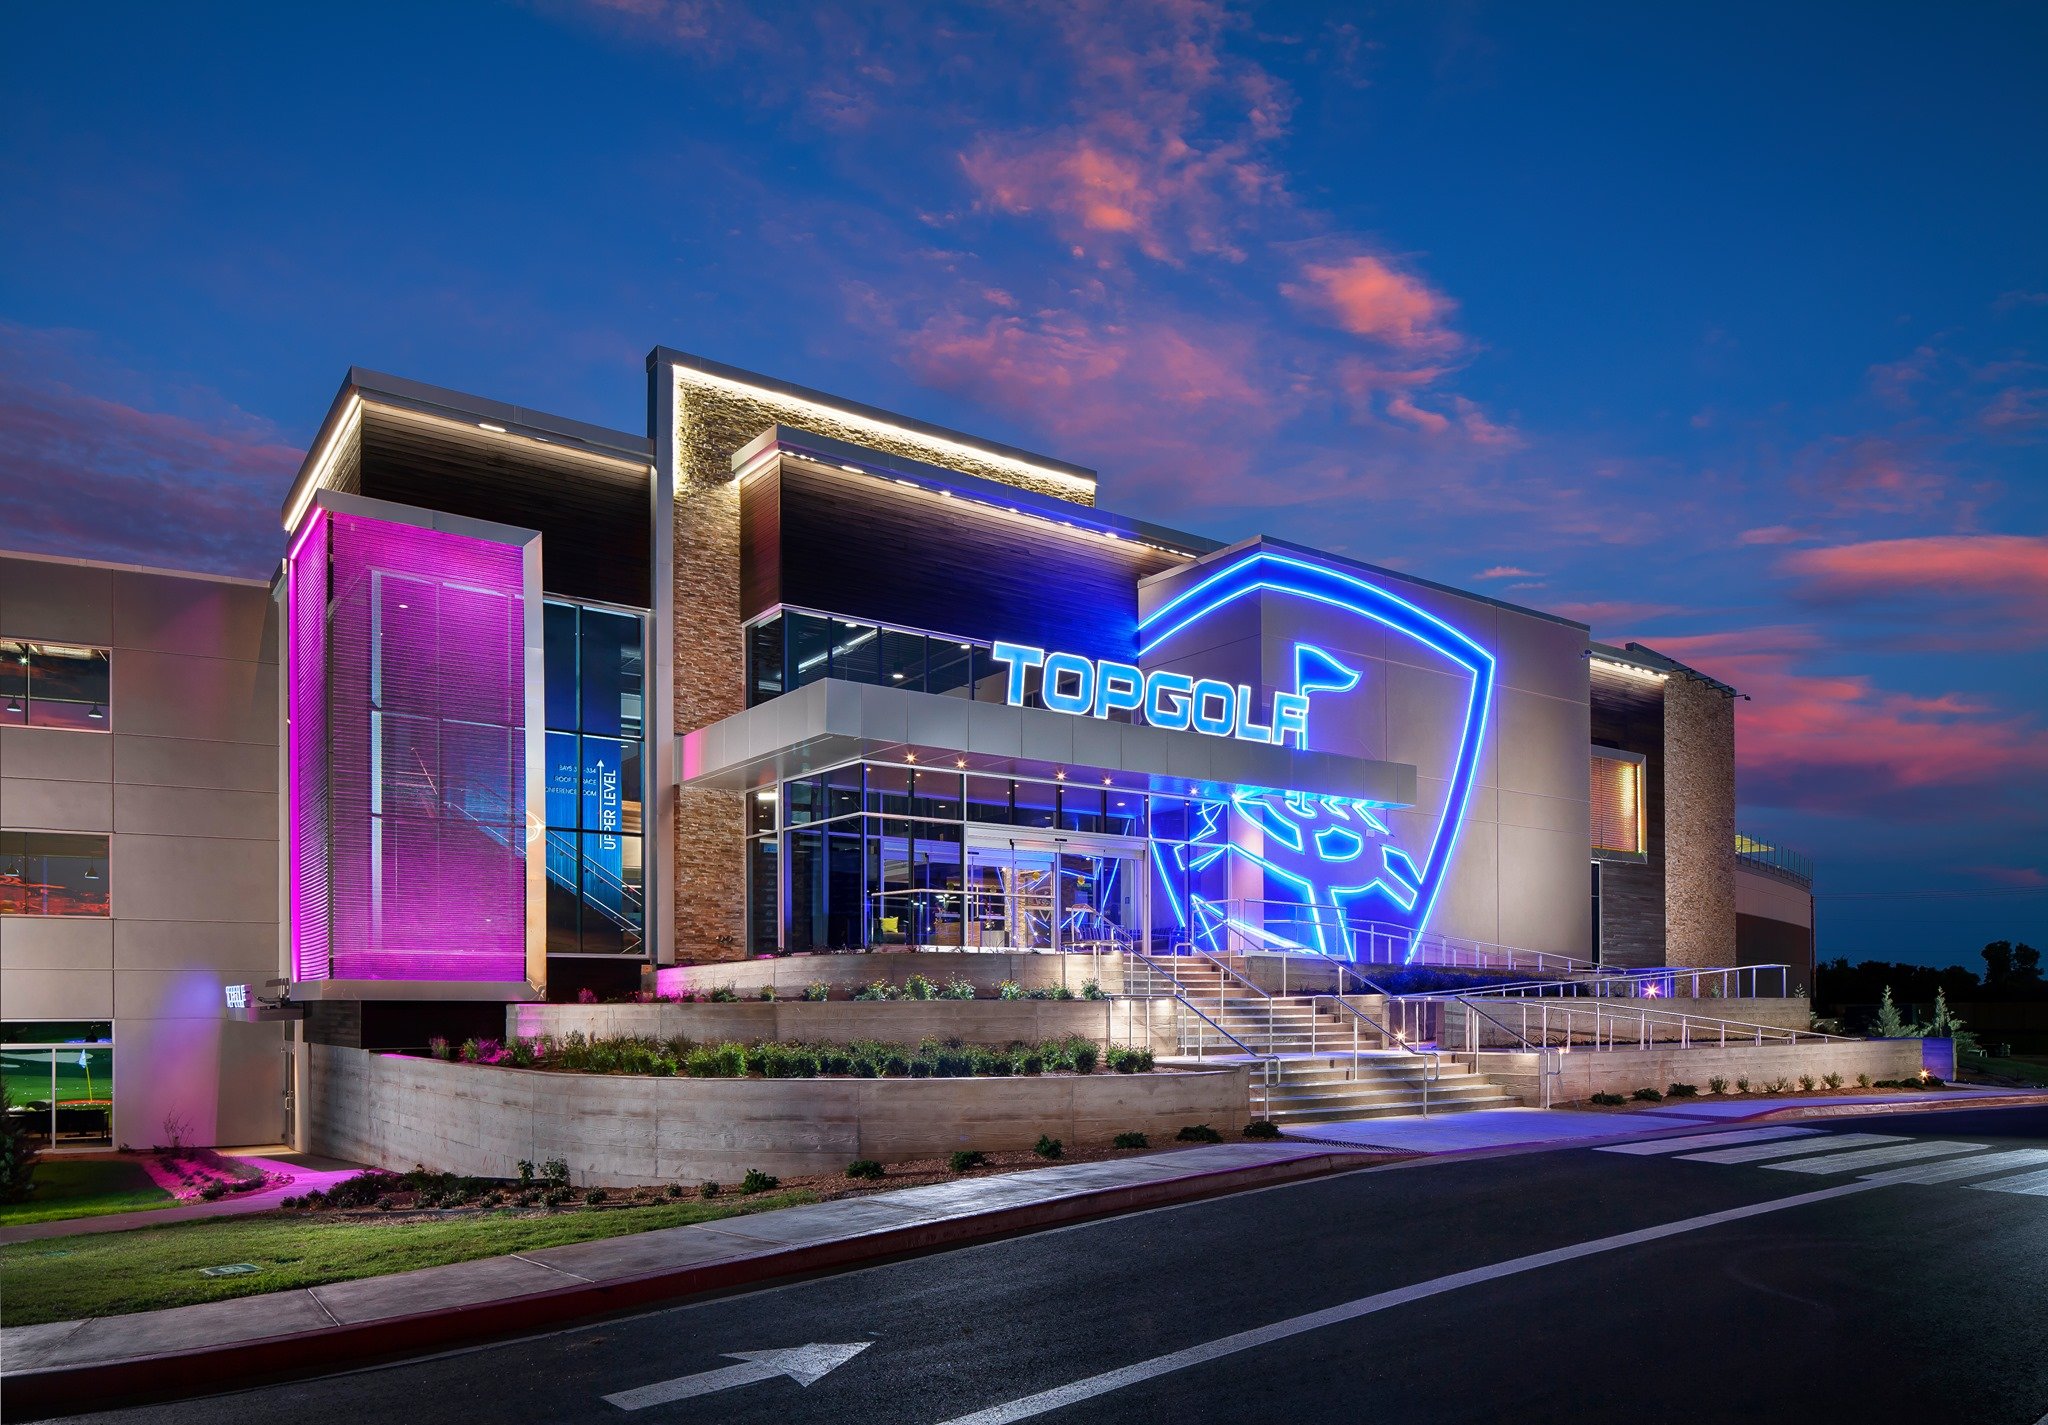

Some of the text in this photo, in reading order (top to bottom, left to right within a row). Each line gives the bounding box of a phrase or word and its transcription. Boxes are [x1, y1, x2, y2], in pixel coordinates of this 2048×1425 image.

[992, 640, 1310, 746] TOPGOLF
[559, 764, 573, 772] BAYS
[554, 775, 572, 783] ROOF
[545, 786, 597, 797] ONFERENCE OOM
[603, 770, 617, 850] UPPER LEVEL
